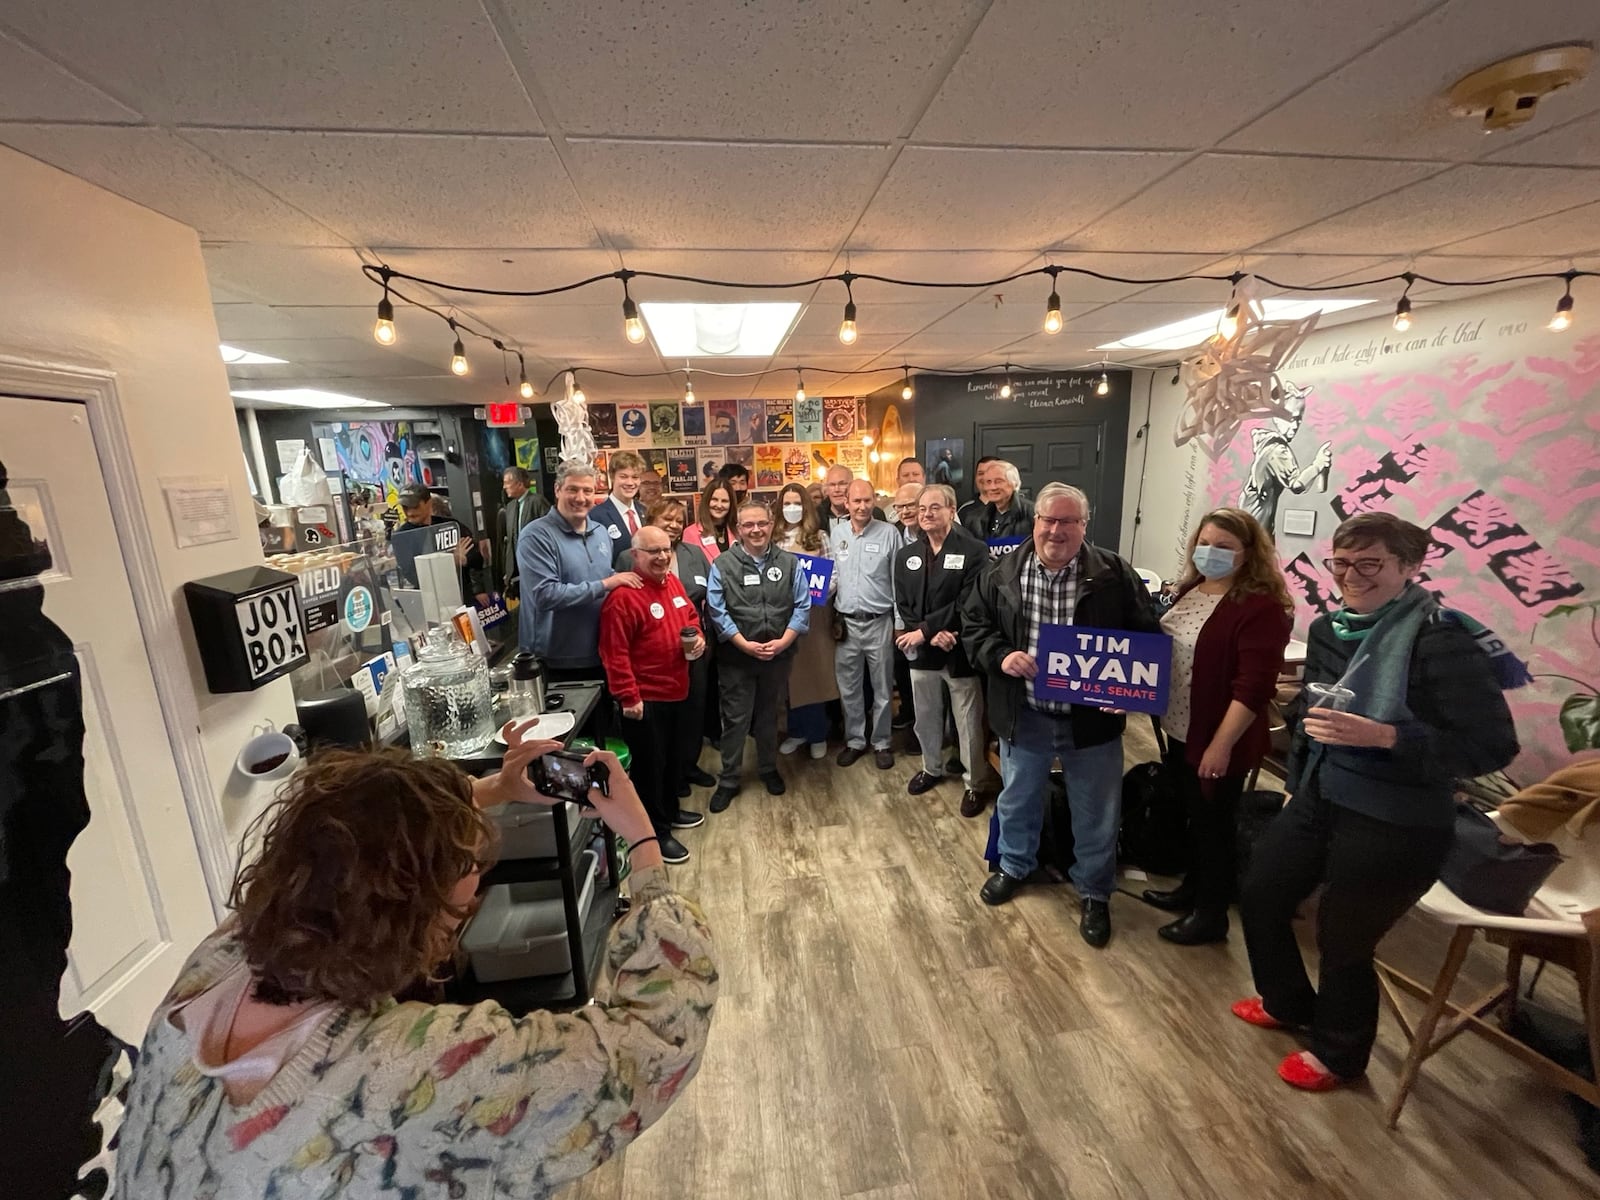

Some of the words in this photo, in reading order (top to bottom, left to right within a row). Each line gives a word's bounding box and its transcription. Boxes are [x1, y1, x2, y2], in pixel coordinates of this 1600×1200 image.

[1405, 338, 1427, 351] can
[1432, 327, 1448, 347] do
[435, 529, 458, 550] YIELD
[298, 566, 340, 598] YIELD
[246, 591, 290, 637] JOY
[478, 603, 500, 619] FIRS
[248, 624, 304, 675] BOX
[1077, 633, 1131, 655] TIM
[1048, 652, 1159, 687] RYAN
[1082, 683, 1105, 694] U.S.
[1107, 685, 1157, 700] SENATE
